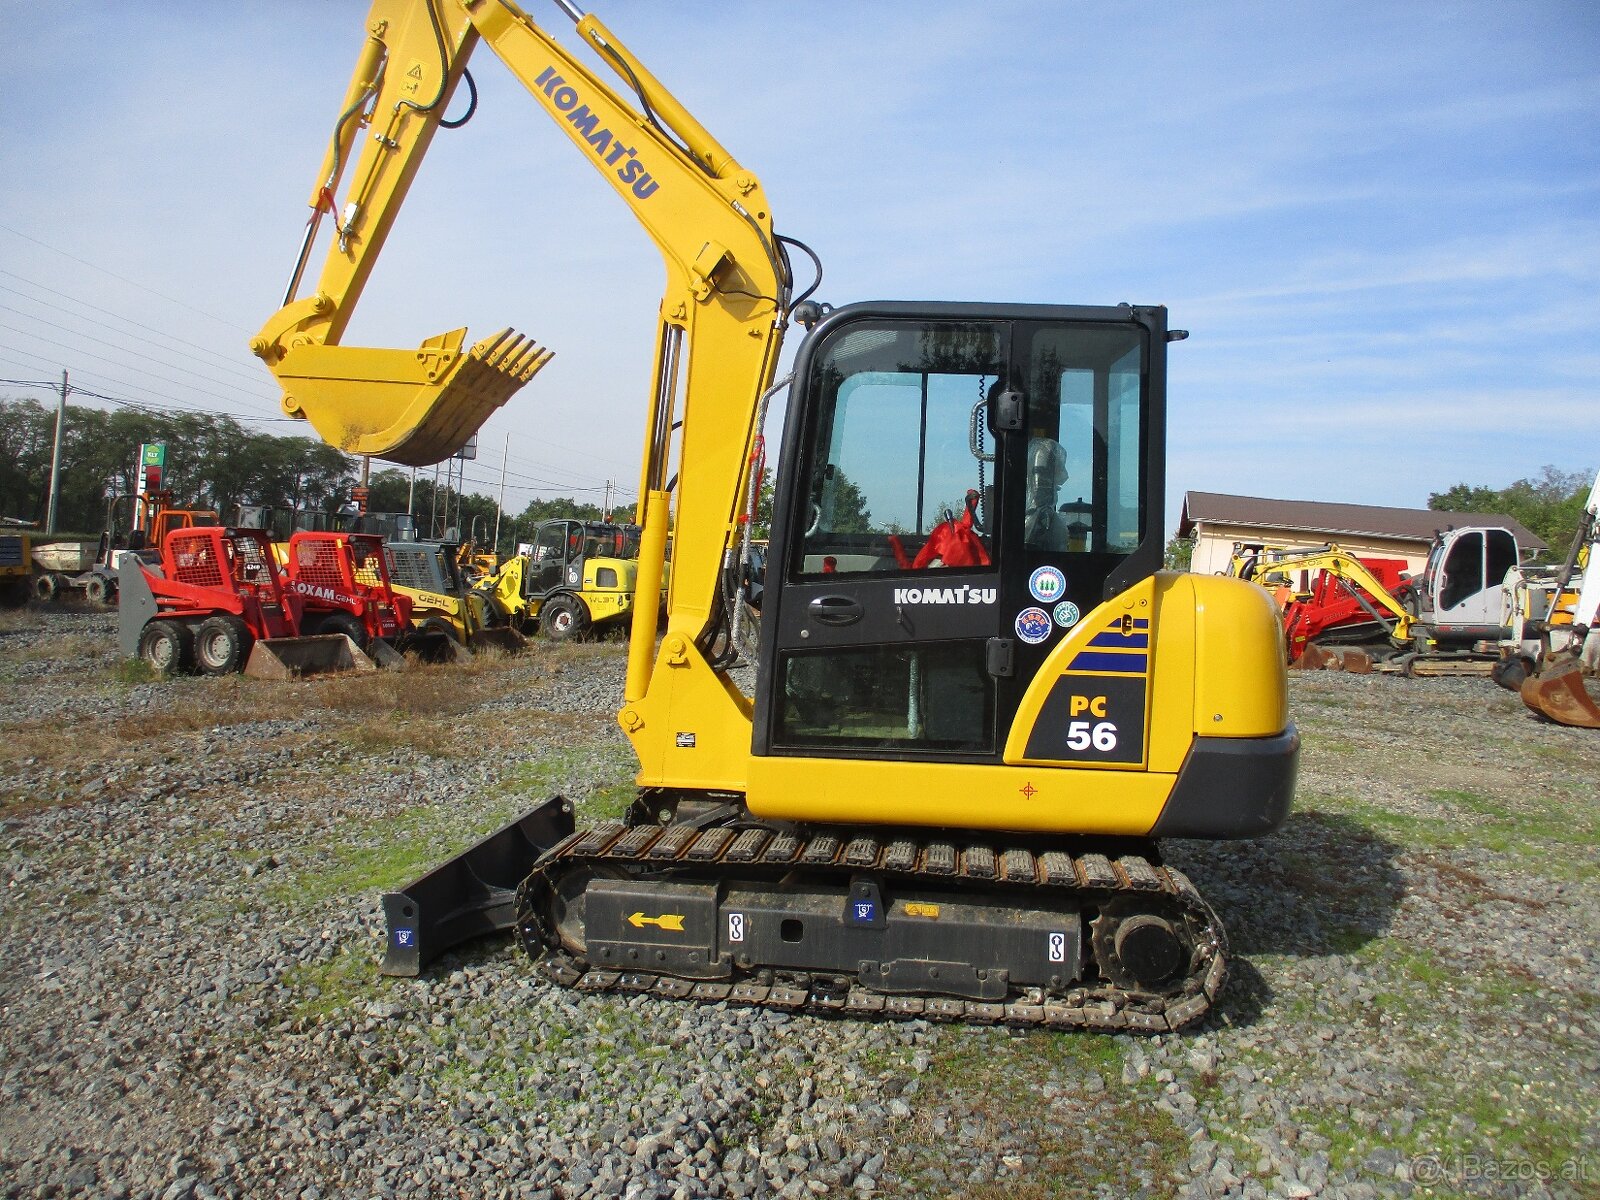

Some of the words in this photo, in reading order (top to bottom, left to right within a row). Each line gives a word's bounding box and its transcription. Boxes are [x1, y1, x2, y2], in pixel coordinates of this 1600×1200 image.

[534, 66, 660, 199] KOMATSU
[418, 594, 450, 607] GEHL
[894, 584, 997, 605] KOMATSU
[1070, 696, 1107, 718] PC
[1067, 722, 1118, 752] 56
